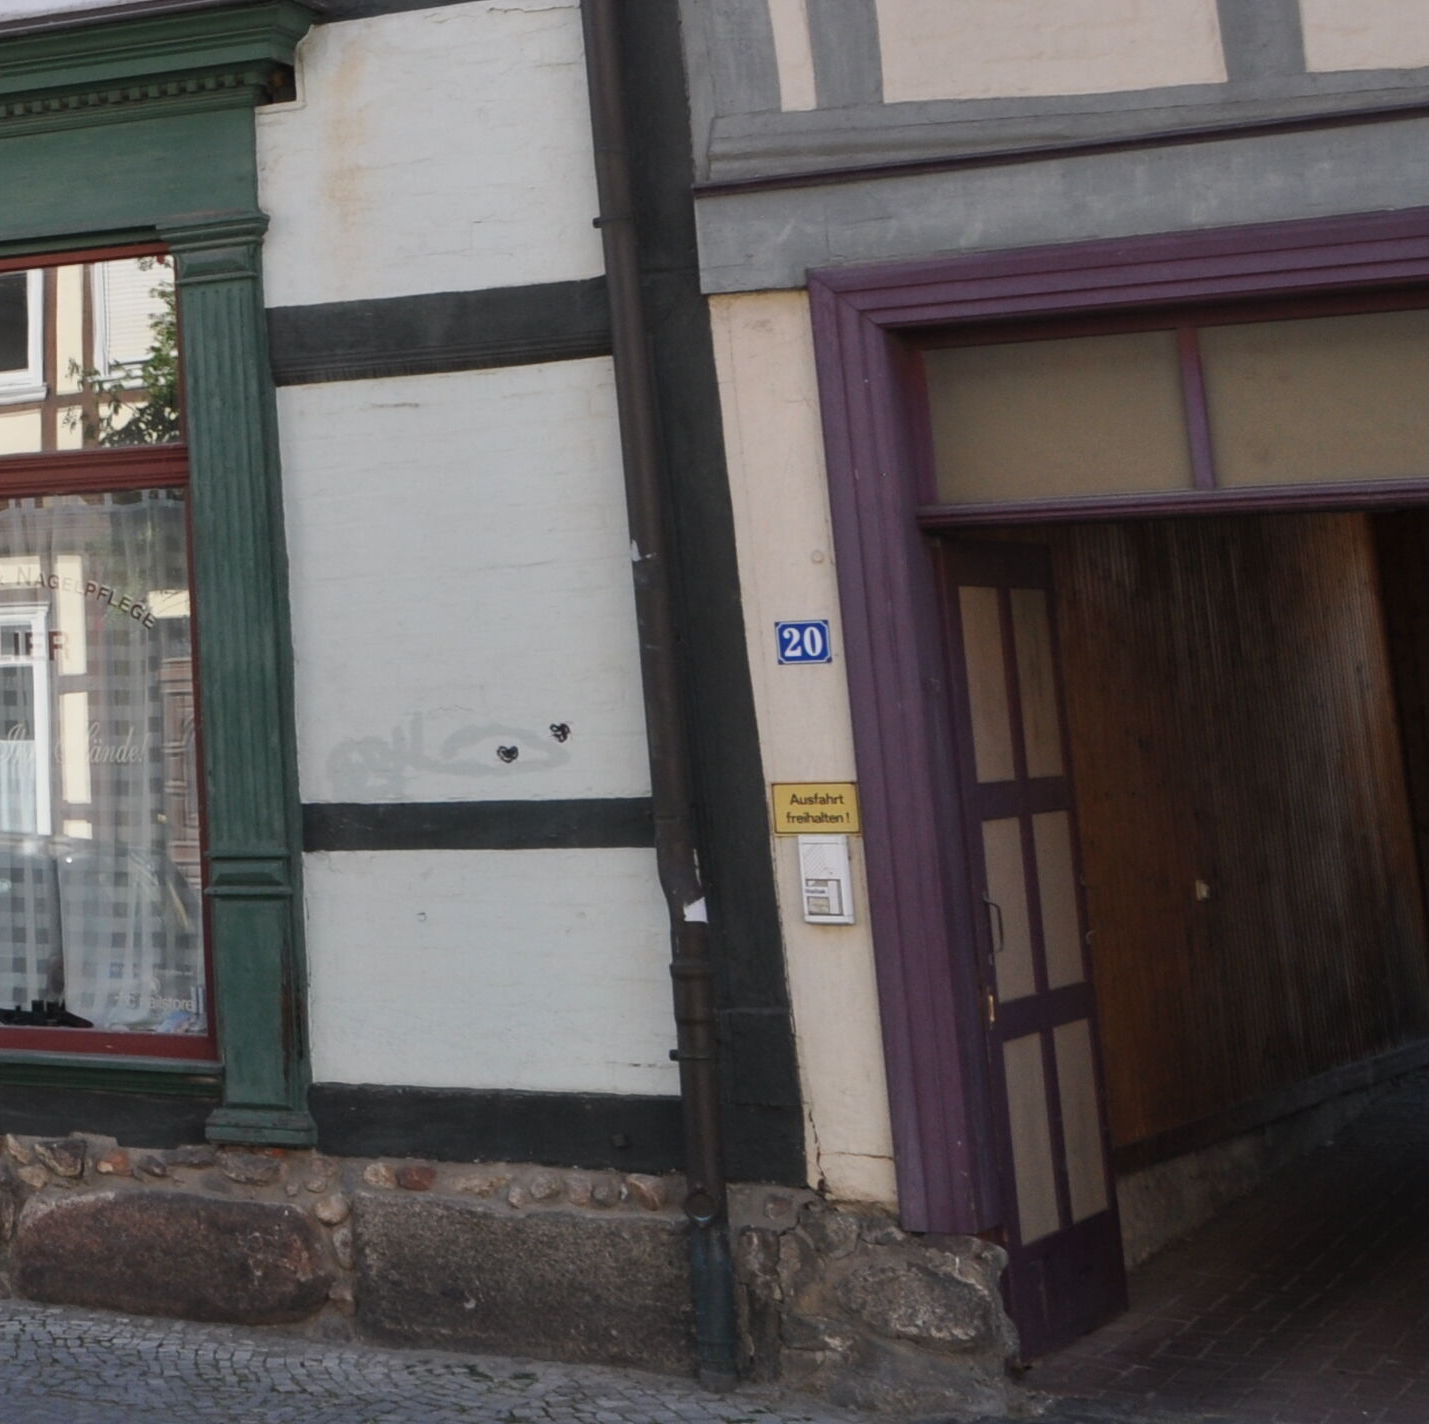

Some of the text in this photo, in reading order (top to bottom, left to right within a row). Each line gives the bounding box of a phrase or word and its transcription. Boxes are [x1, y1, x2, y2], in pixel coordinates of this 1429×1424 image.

[15, 564, 158, 631] NAGELPFLEGE
[782, 626, 823, 657] 20
[789, 792, 845, 805] Ausfahrt
[786, 811, 844, 824] freihalten
